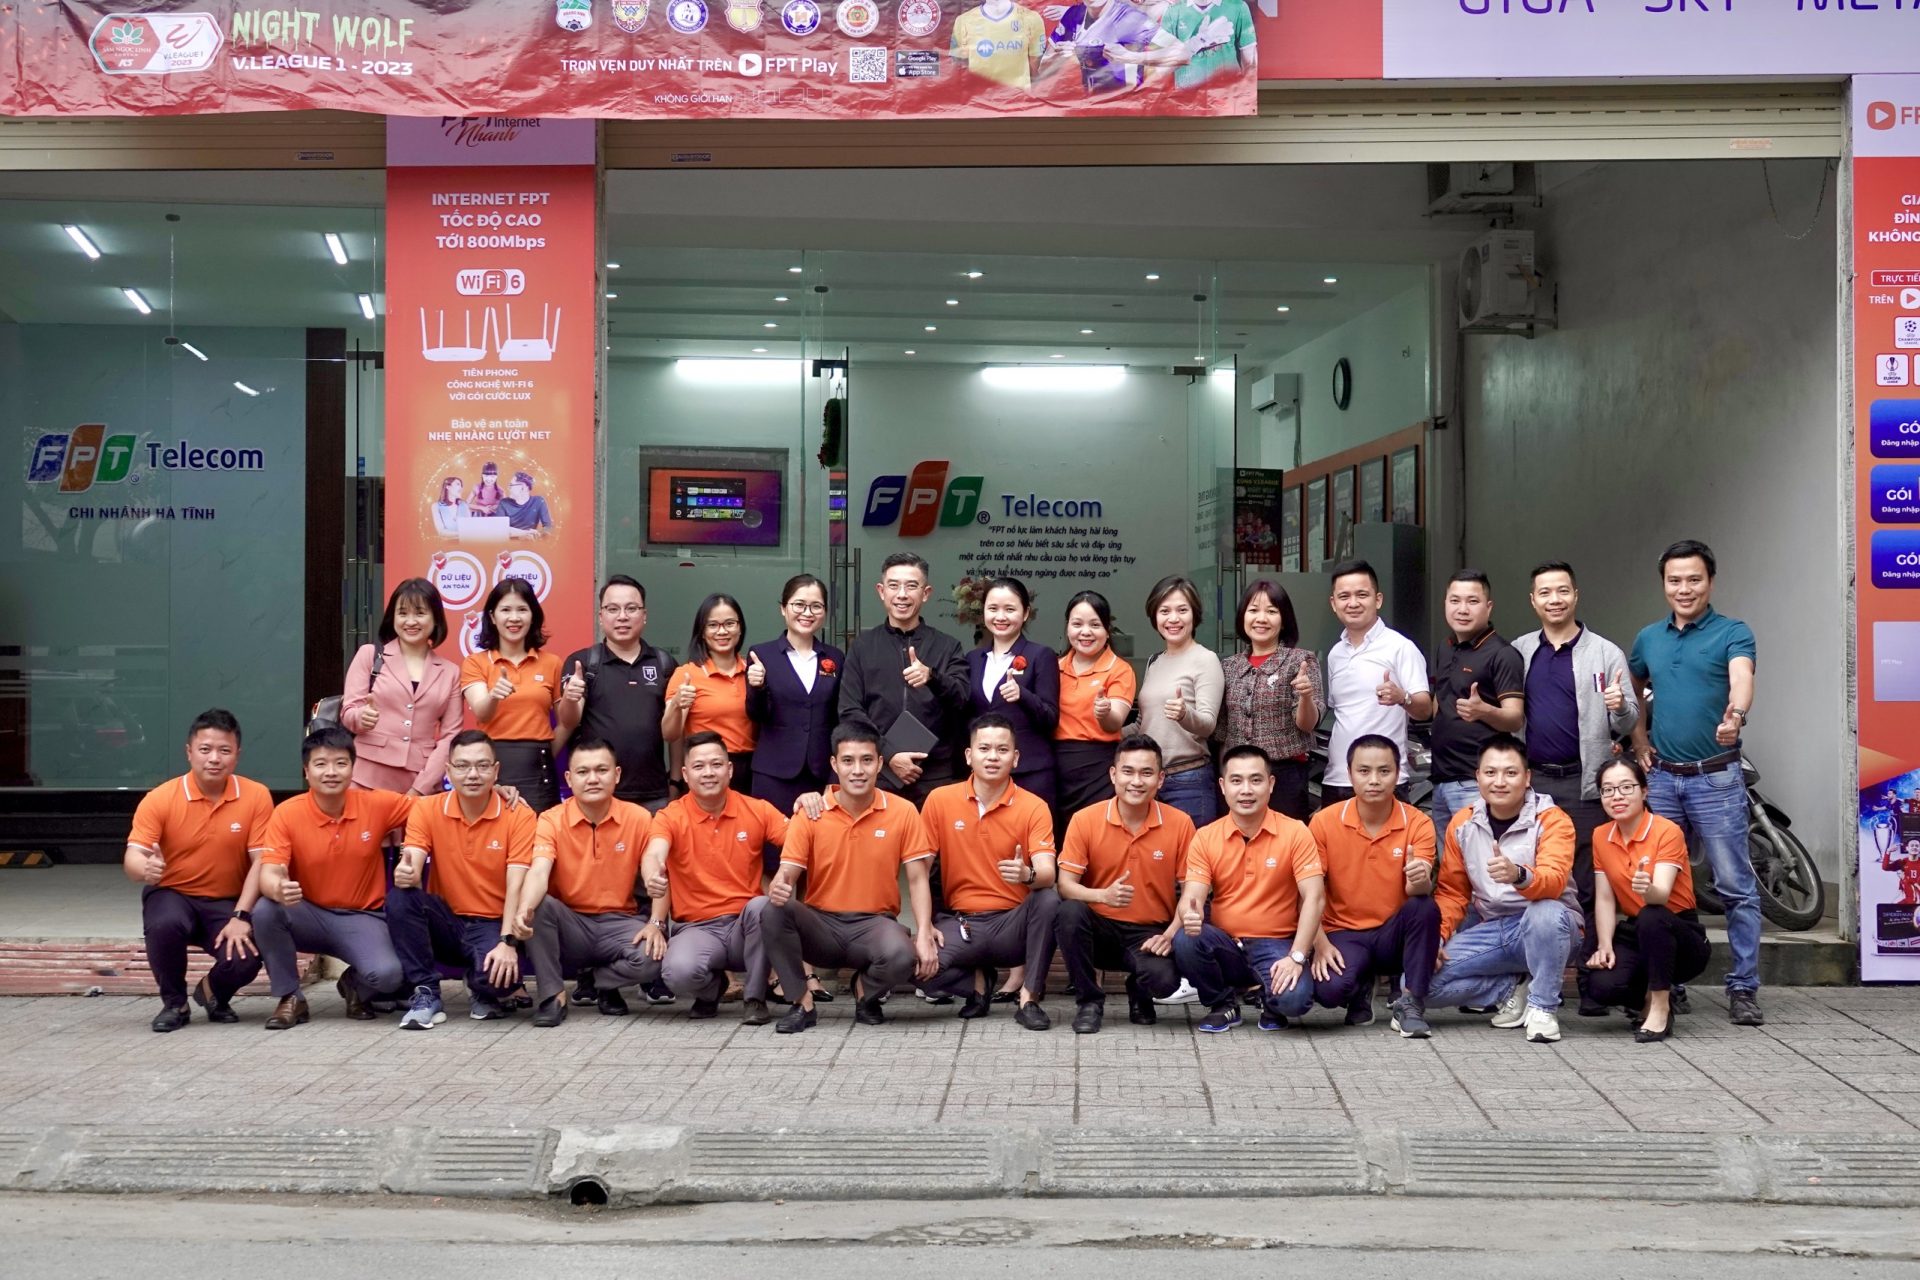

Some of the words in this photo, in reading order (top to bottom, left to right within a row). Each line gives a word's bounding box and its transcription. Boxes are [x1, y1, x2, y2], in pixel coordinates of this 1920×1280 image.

[232, 8, 320, 50] NIGHT
[334, 13, 414, 59] WOLF
[232, 55, 331, 72] V.LEAGUE
[335, 56, 346, 72] 1
[362, 60, 414, 75] 2023
[560, 60, 596, 74] TRỌN
[600, 60, 626, 74] VẸN
[630, 60, 655, 71] DUY
[658, 56, 694, 70] NHẤT
[697, 58, 732, 71] TRÊN
[766, 58, 798, 72] FPT
[802, 58, 838, 76] Play
[654, 93, 688, 103] KHÔNG
[494, 117, 541, 128] Internet
[445, 122, 522, 147] Nhanh
[432, 193, 515, 205] INTERNET
[519, 192, 550, 204] FPT
[440, 209, 473, 227] TỐC
[477, 211, 502, 230] ĐỘ
[505, 214, 542, 226] CAO
[436, 233, 464, 248] TỚI
[467, 235, 546, 250] 800Mbps
[461, 275, 501, 289] WiFi
[510, 275, 520, 289] 6
[1880, 275, 1904, 284] TRỰC
[1906, 272, 1920, 282] TIẾ
[1869, 294, 1894, 304] TRÊN
[462, 368, 483, 376] TIÊN
[447, 380, 473, 388] CÔNG
[467, 392, 483, 400] GÓI
[451, 418, 471, 428] Bảo
[505, 418, 528, 428] toàn
[429, 432, 452, 443] NHẸ
[455, 429, 495, 441] NHÀNG
[530, 431, 551, 440] NET
[146, 441, 264, 470] Telecom
[1886, 487, 1912, 500] GÓI
[69, 507, 94, 518] CHI
[1002, 494, 1102, 518] Telecom
[1045, 526, 1067, 534] khách
